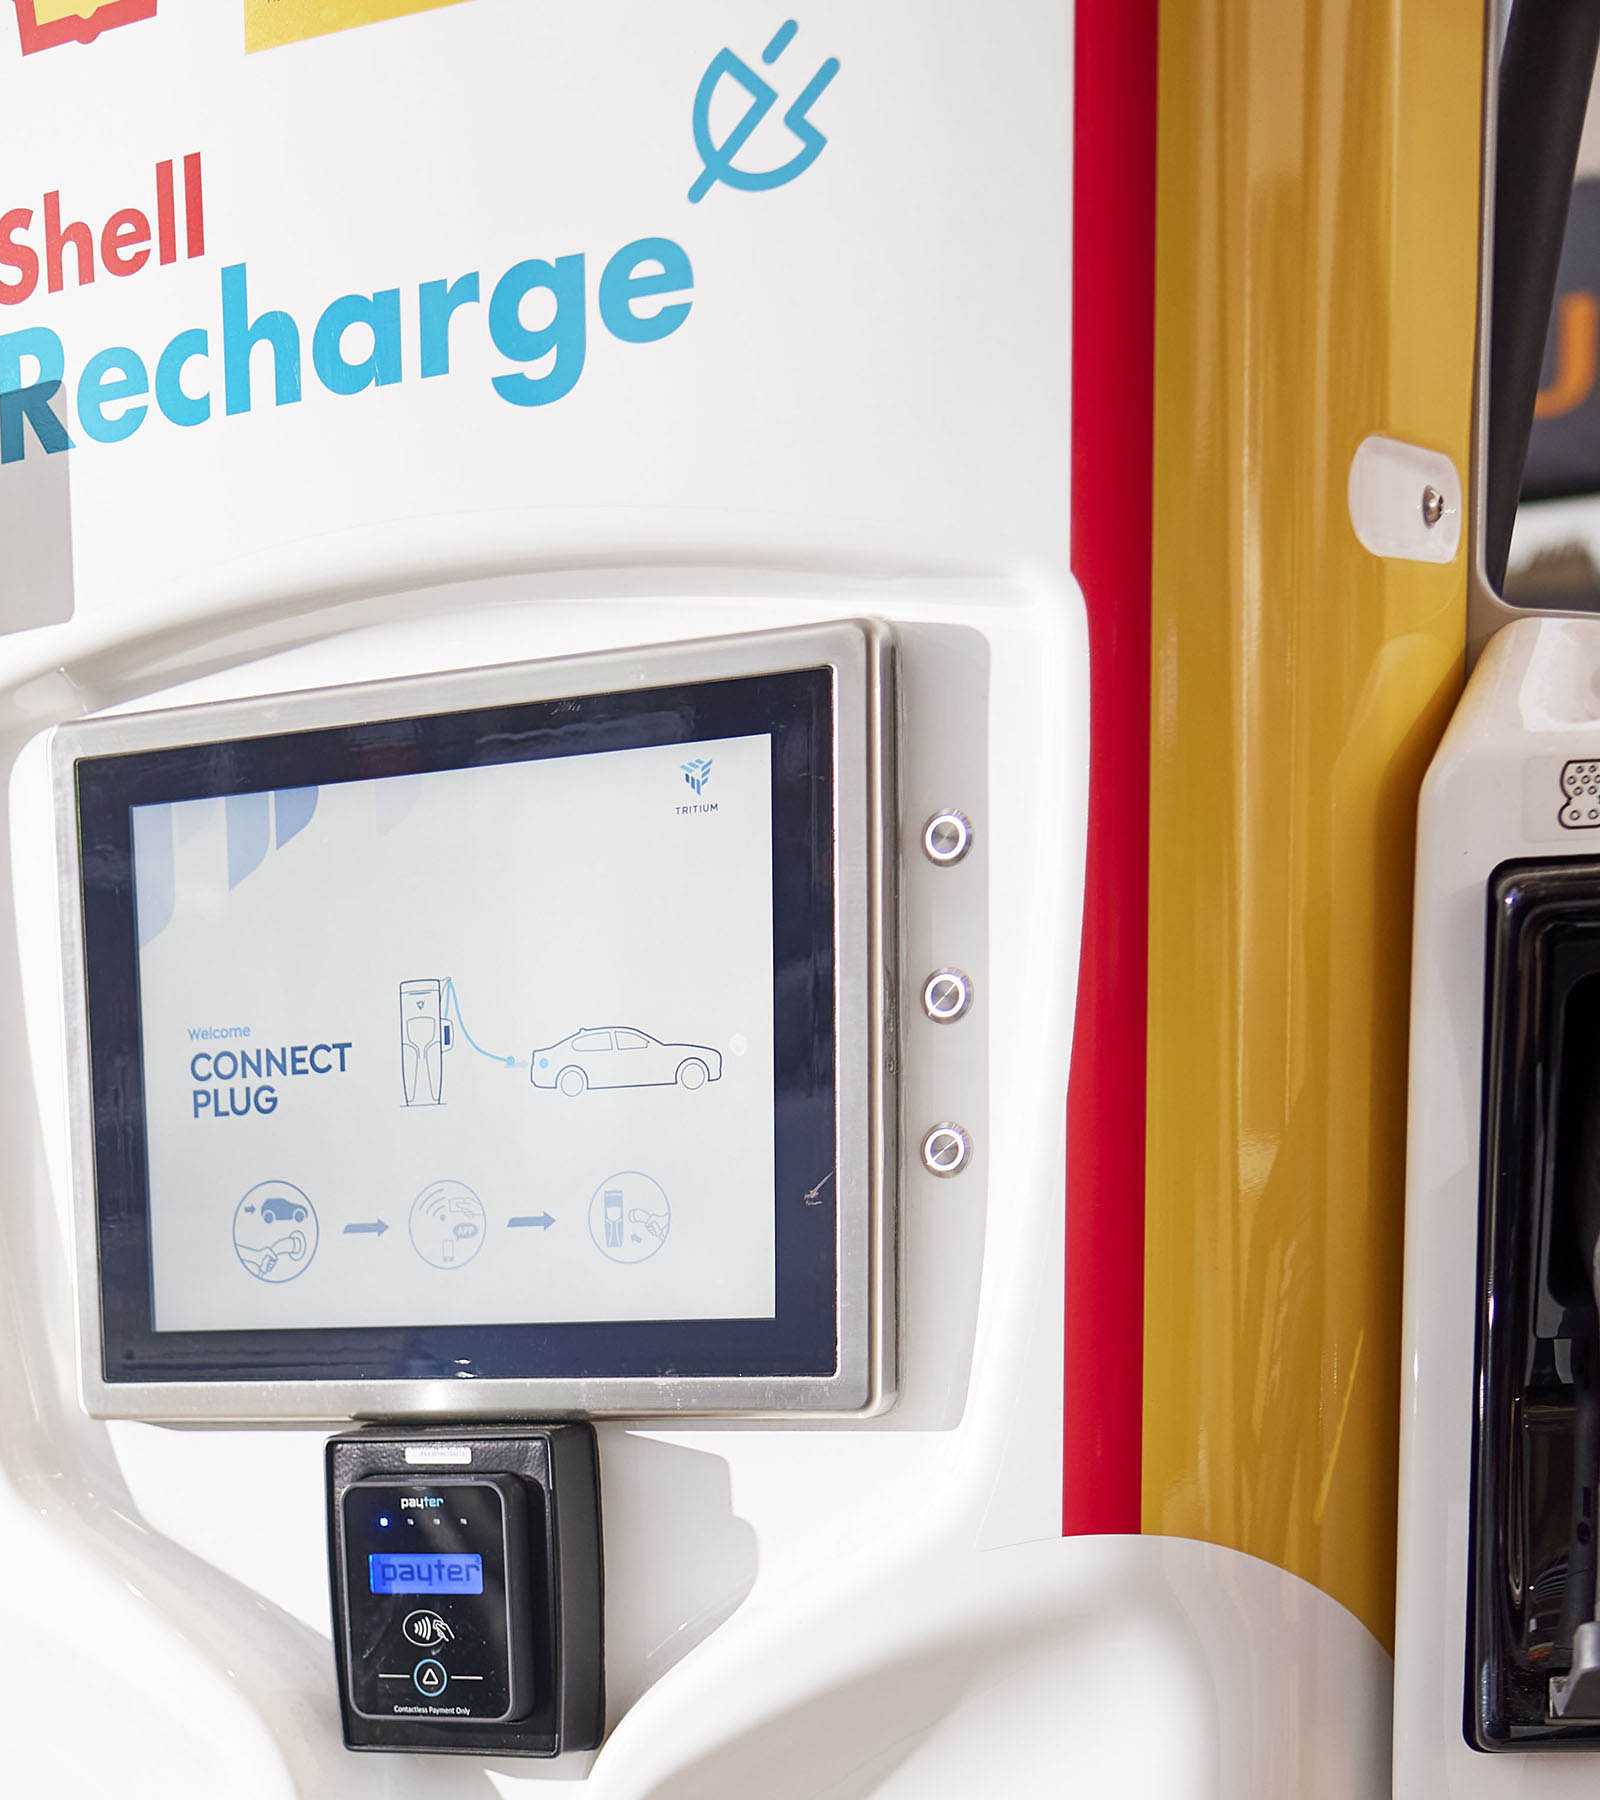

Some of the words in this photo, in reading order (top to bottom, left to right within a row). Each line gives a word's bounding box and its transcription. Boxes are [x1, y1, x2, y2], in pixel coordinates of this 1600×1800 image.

[675, 803, 719, 815] TRITIUM
[188, 1023, 251, 1041] Welcome
[190, 1043, 352, 1082] CONNECT
[192, 1085, 279, 1119] PLUG
[400, 1496, 444, 1510] payter
[381, 1560, 480, 1586] payter
[393, 1704, 428, 1714] Contactless
[429, 1705, 455, 1716] Payment
[456, 1706, 471, 1716] Only
